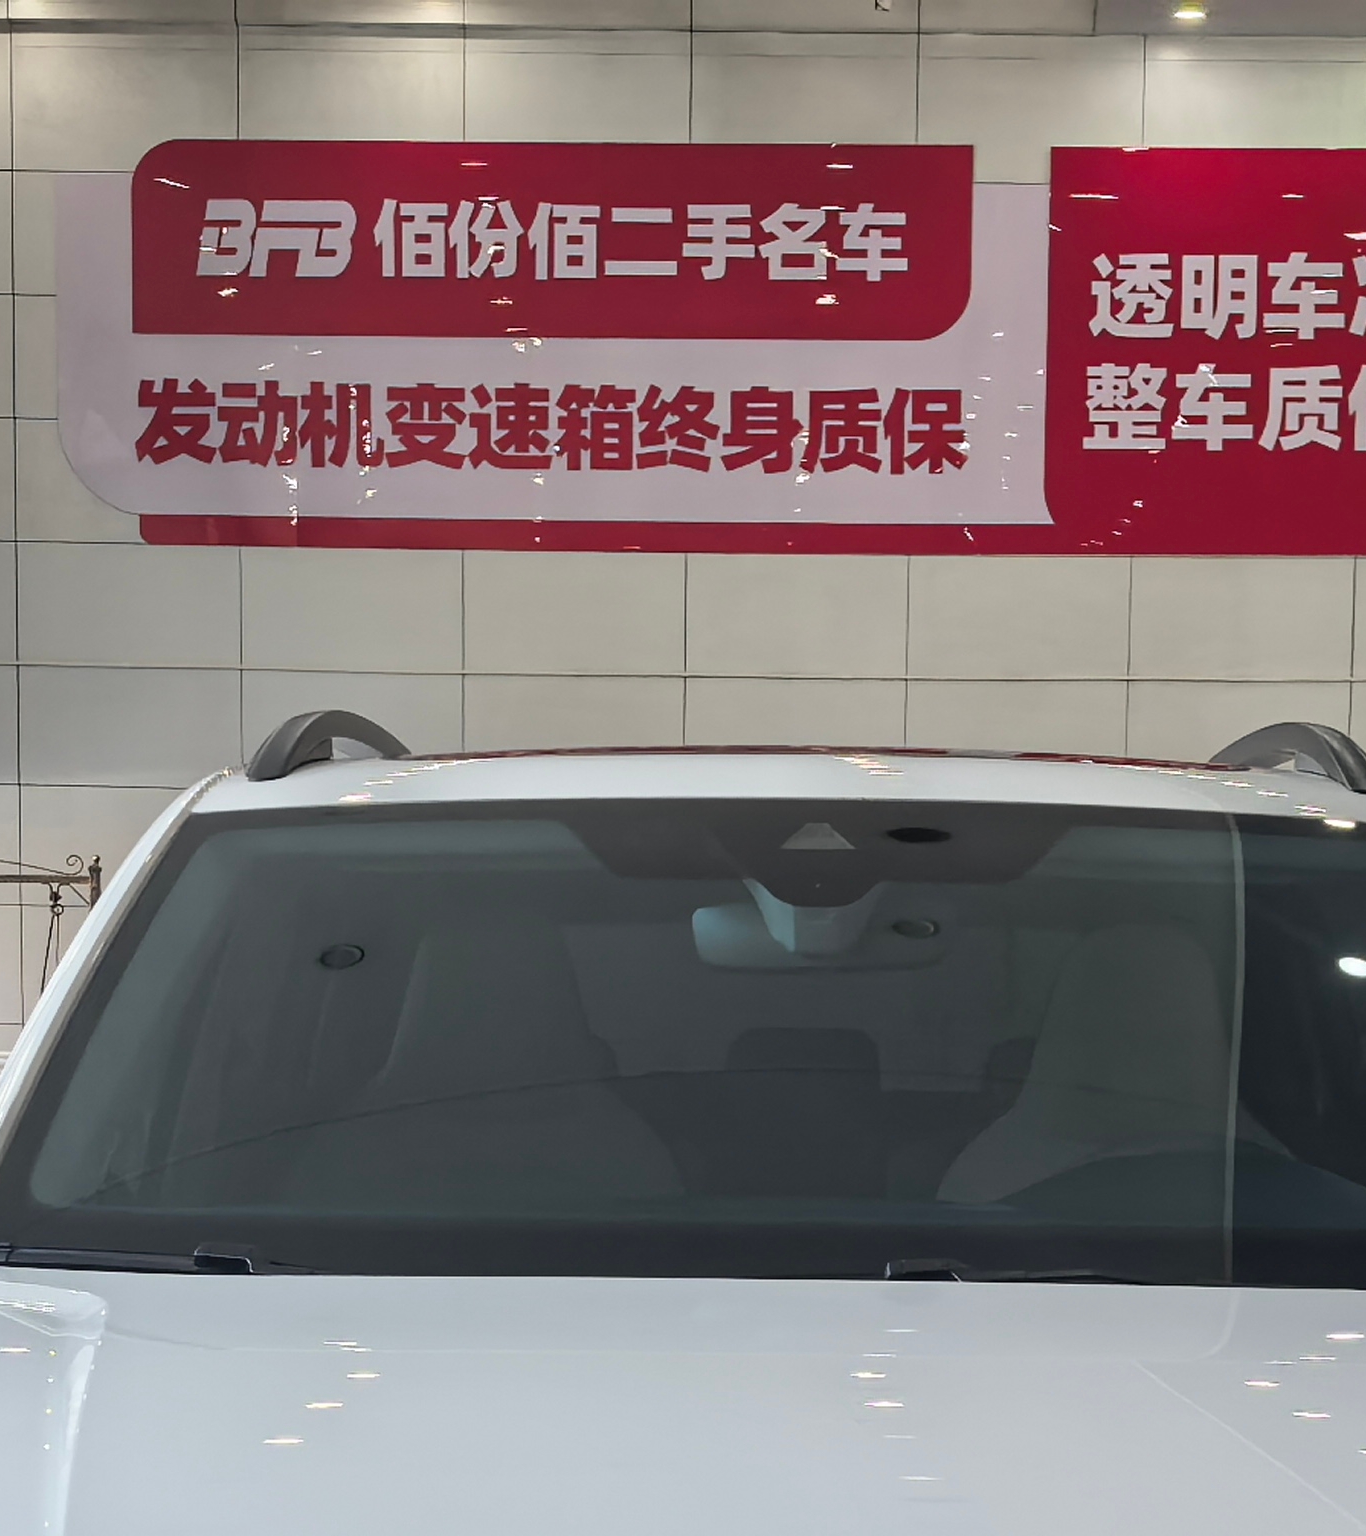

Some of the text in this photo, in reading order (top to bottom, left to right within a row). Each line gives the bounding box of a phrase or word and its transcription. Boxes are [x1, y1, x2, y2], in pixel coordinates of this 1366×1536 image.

[373, 198, 908, 282] 佰份佰二手名车
[134, 378, 969, 476] 发动机变速箱终身质保
